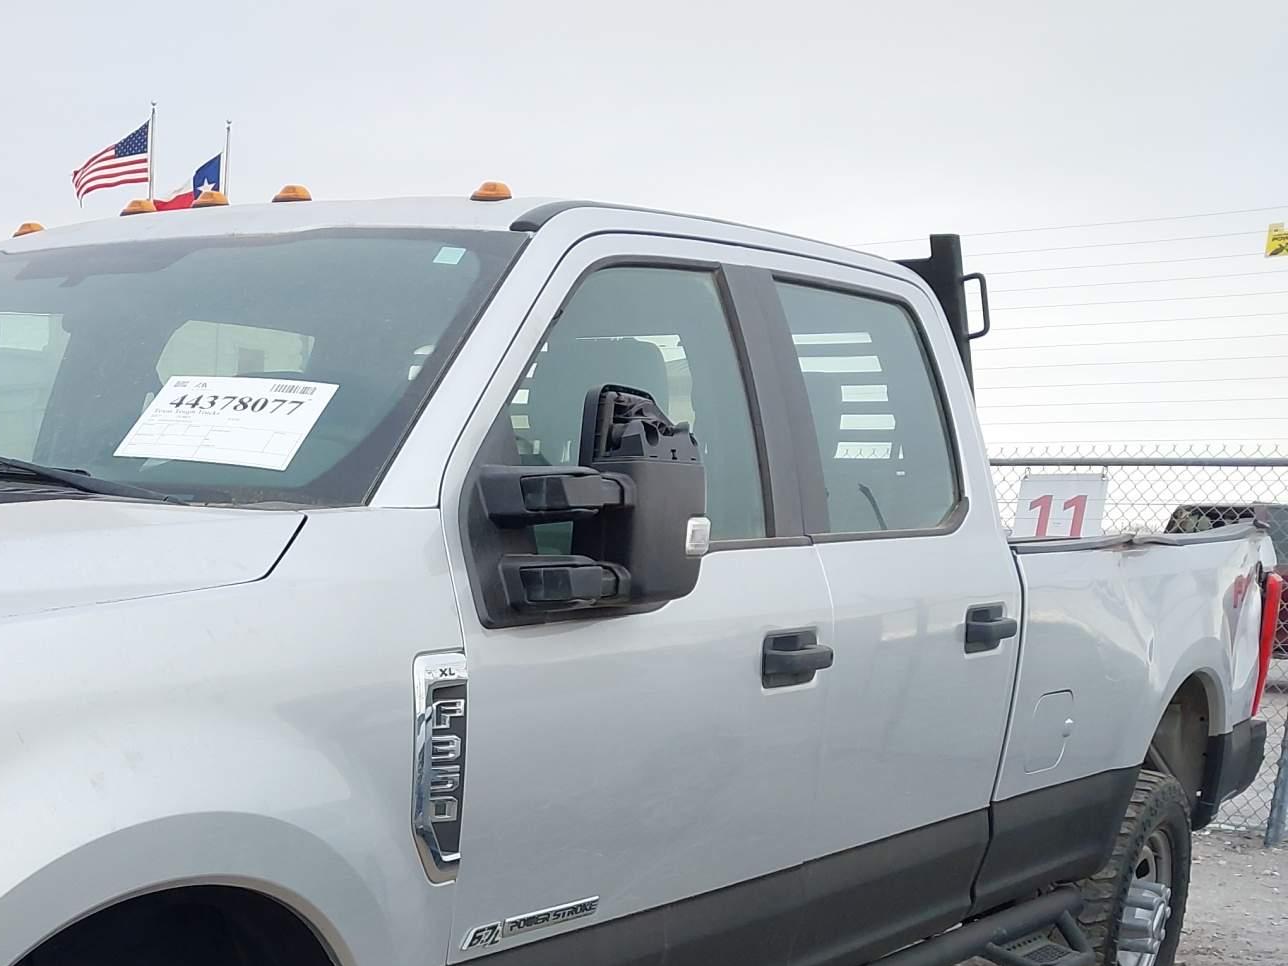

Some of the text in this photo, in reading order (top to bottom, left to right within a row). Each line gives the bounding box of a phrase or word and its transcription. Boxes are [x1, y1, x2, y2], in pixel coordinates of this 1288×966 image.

[169, 394, 305, 416] 44378077
[1029, 494, 1088, 538] 11
[438, 667, 456, 678] XL
[509, 912, 552, 933] POWER
[552, 899, 599, 921] STROKE
